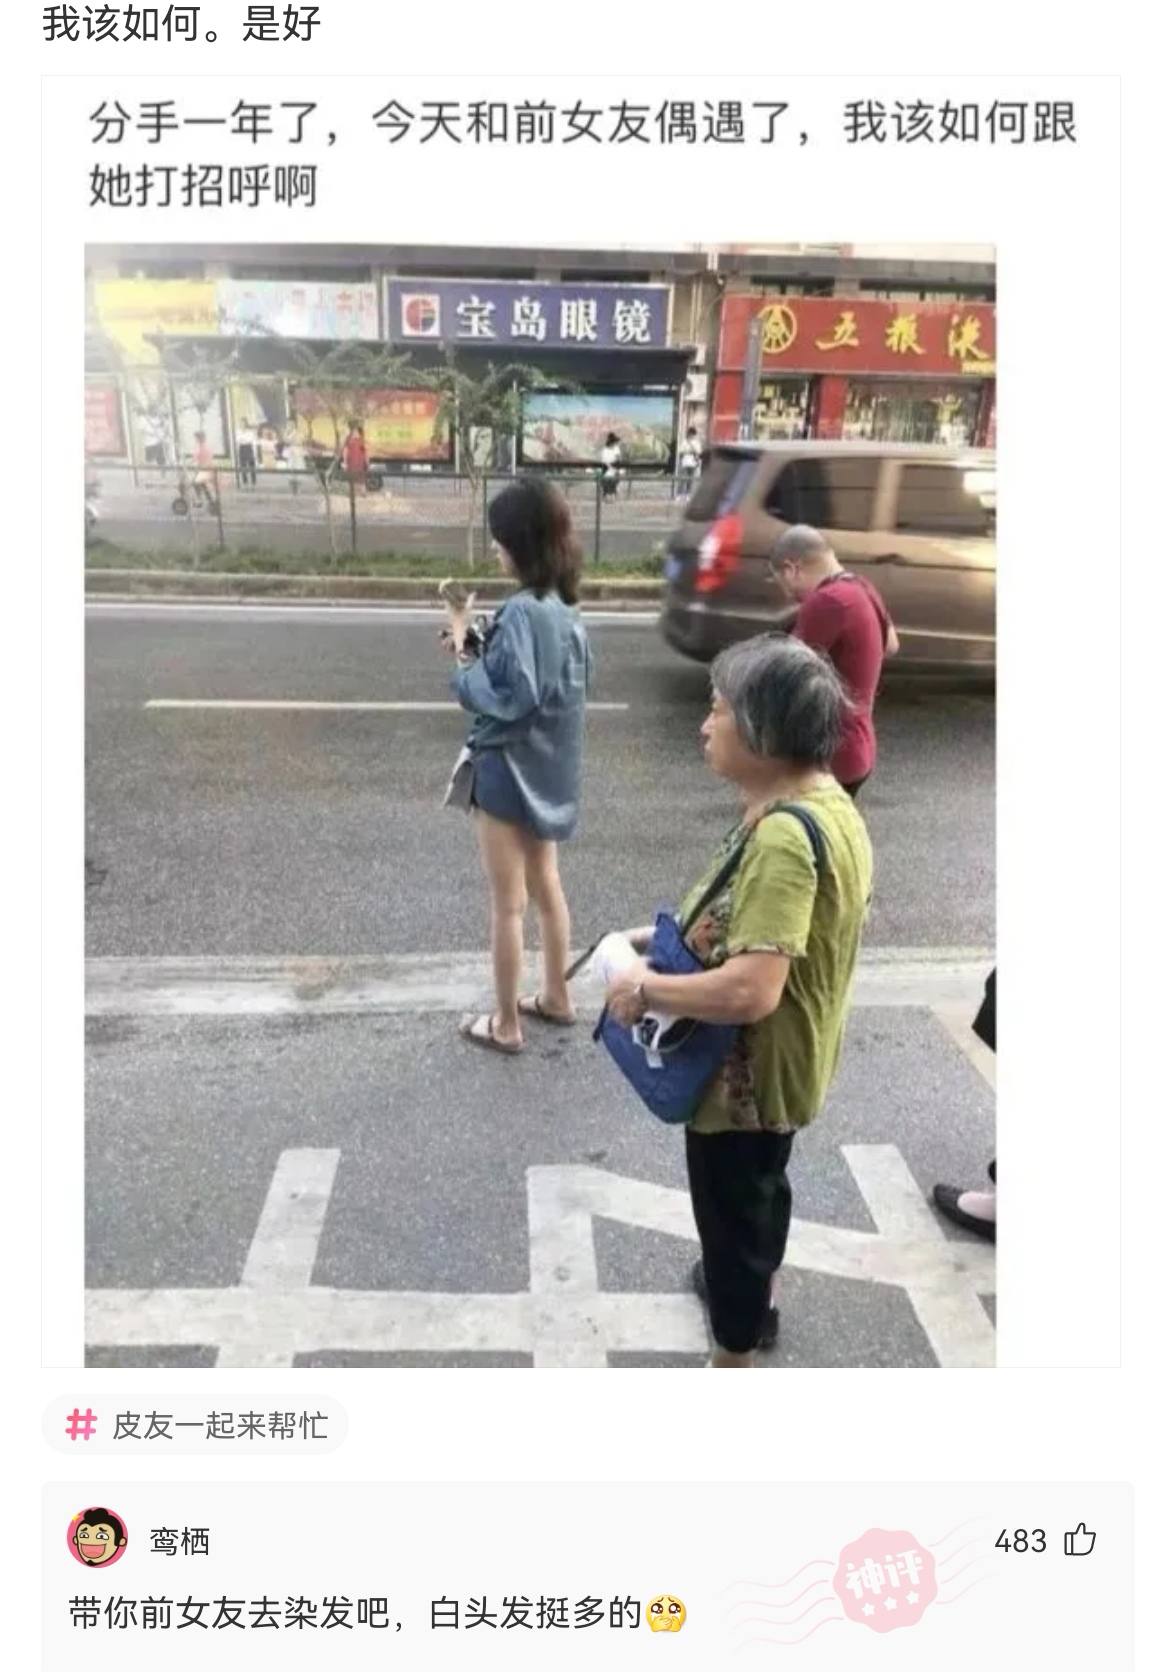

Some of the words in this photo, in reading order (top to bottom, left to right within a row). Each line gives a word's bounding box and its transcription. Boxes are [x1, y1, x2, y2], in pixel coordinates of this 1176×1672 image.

[456, 295, 652, 344] 宝岛眼镜
[815, 311, 990, 359] 五粮液
